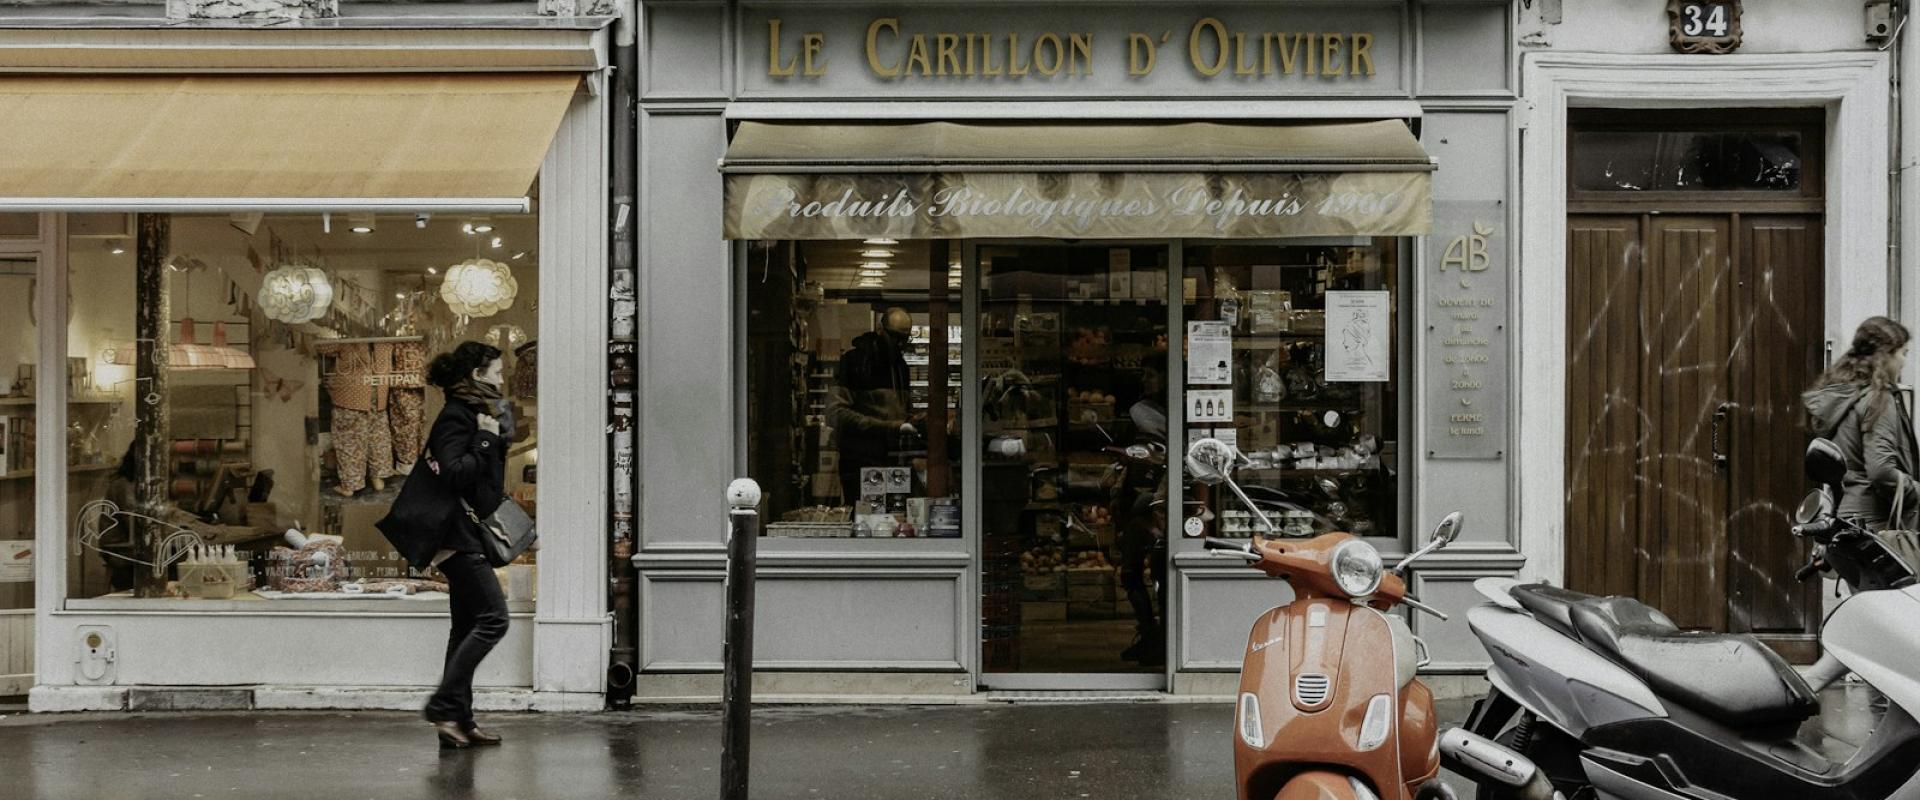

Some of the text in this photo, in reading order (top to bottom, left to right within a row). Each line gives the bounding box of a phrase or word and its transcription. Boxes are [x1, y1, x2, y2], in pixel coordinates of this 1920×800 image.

[1684, 5, 1728, 36] 34
[928, 184, 1158, 231] Biologiques
[1172, 187, 1308, 229] Depuis
[1440, 234, 1490, 271] AB
[363, 373, 421, 386] PETITPAN
